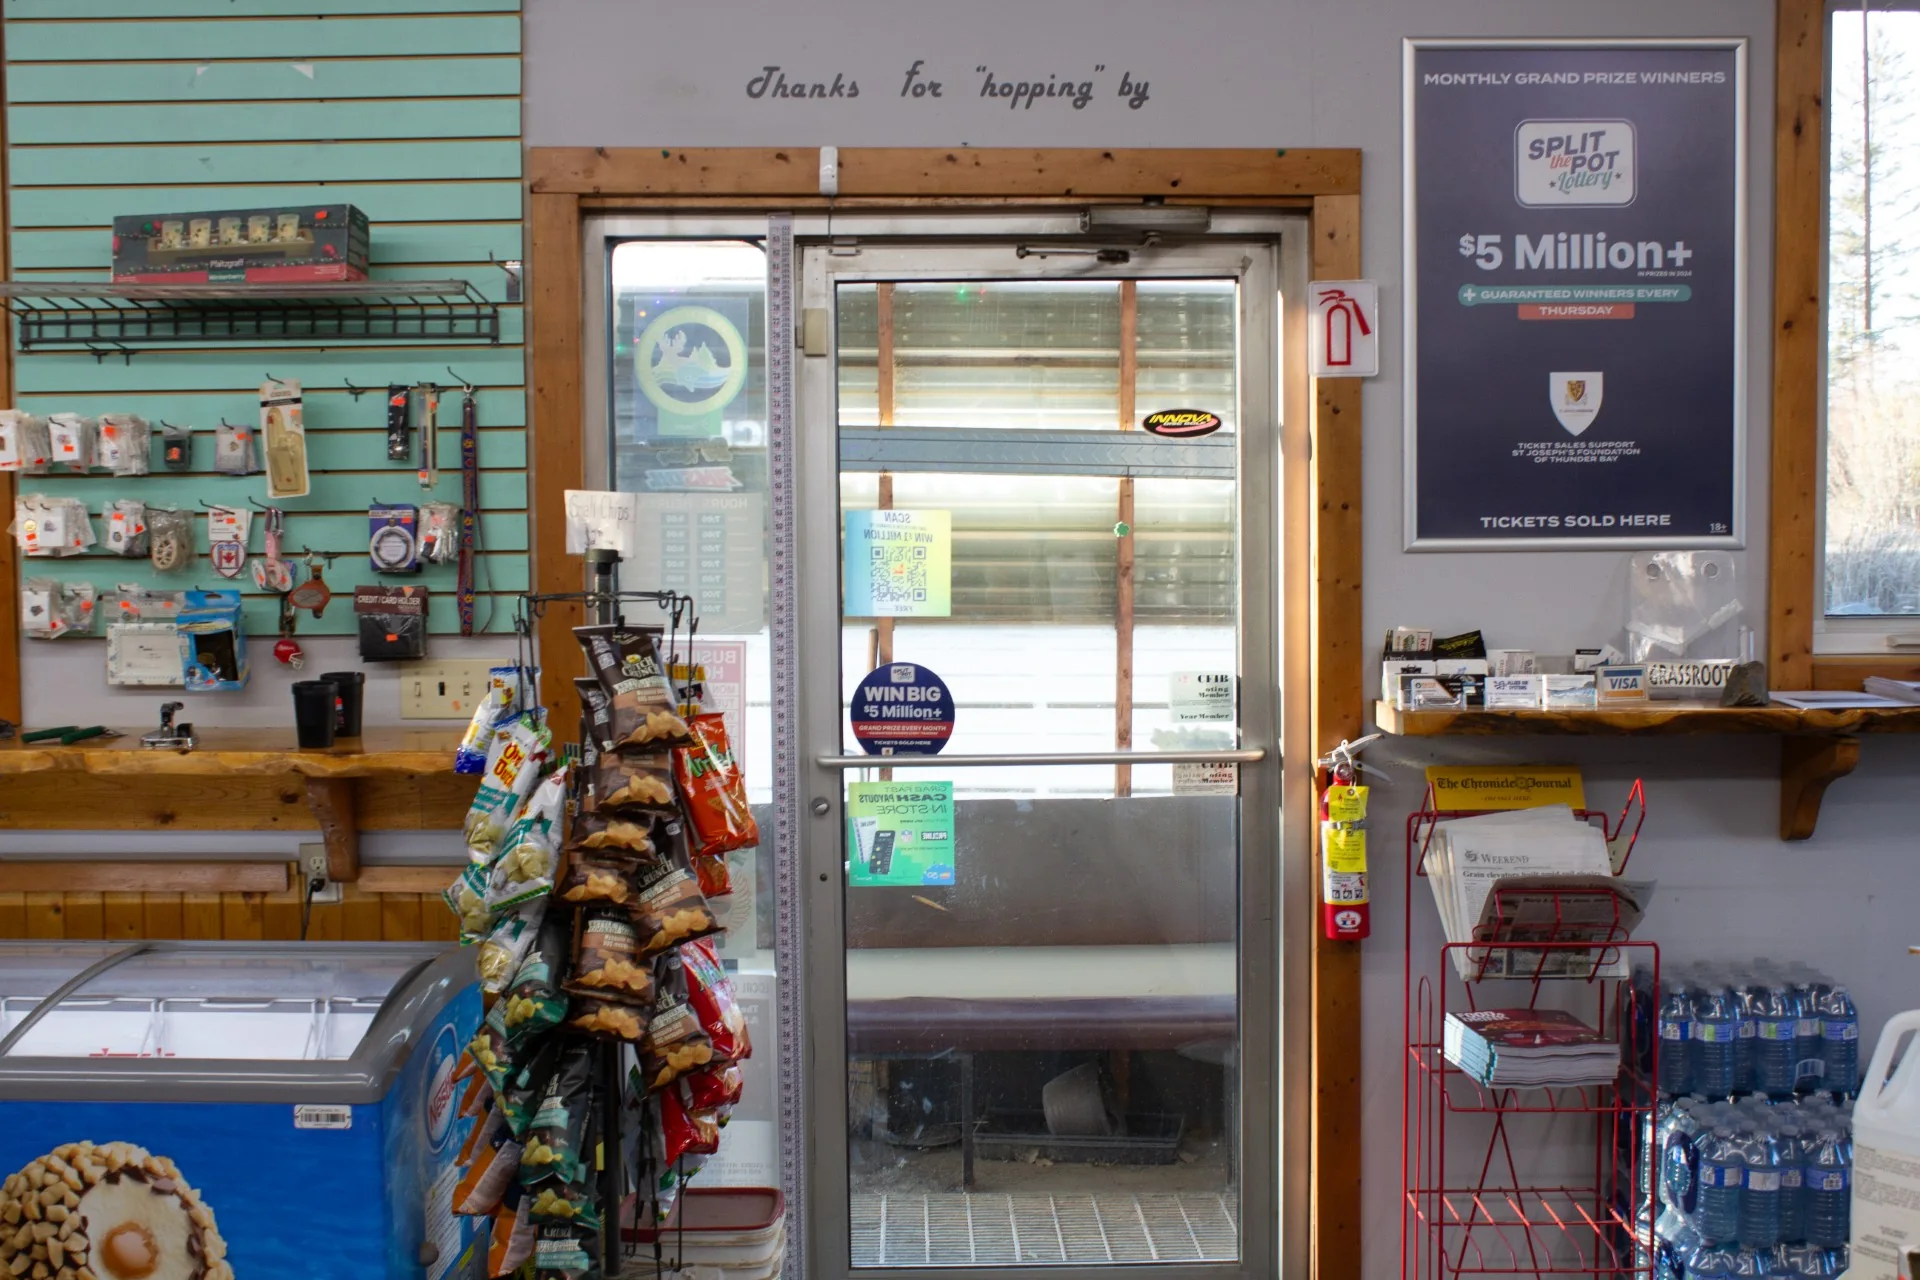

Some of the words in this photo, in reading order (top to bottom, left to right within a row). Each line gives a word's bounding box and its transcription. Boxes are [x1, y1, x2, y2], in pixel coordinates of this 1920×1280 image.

[1424, 72, 1511, 85] MONTHLY
[1514, 72, 1580, 85] GRAND
[1583, 72, 1637, 84] PRIZE
[1640, 71, 1726, 84] WINNERS
[746, 66, 860, 99] Thanks
[900, 60, 943, 98] for
[1118, 71, 1150, 110] by
[1527, 130, 1606, 160] SPLIT
[1549, 153, 1571, 170] the
[1570, 150, 1620, 175] POT
[1557, 169, 1614, 195] Lottery
[1459, 233, 1503, 271] $5
[1514, 232, 1692, 270] Million+
[1480, 289, 1571, 300] GUARANTEED
[1573, 289, 1635, 299] WINNERS
[1636, 288, 1680, 299] EVERY
[1539, 305, 1613, 316] THURSDAY
[1149, 413, 1212, 423] INNOVA
[1576, 448, 1641, 456] FOUNDATION
[1480, 516, 1560, 529] TICKETS
[1564, 516, 1616, 527] SOLD
[1620, 515, 1672, 526] HERE
[1709, 523, 1728, 532] 18+
[397, 597, 421, 605] HOLDER
[1609, 677, 1638, 690] VISA
[864, 687, 904, 702] WIN
[907, 686, 941, 702] BIG
[864, 705, 879, 718] $5
[882, 705, 943, 718] Million+
[1437, 777, 1459, 789] The
[1461, 777, 1515, 789] Chronicle
[1527, 777, 1572, 789] Journal
[1481, 853, 1529, 865] WEEKEND
[1463, 870, 1485, 878] Grain
